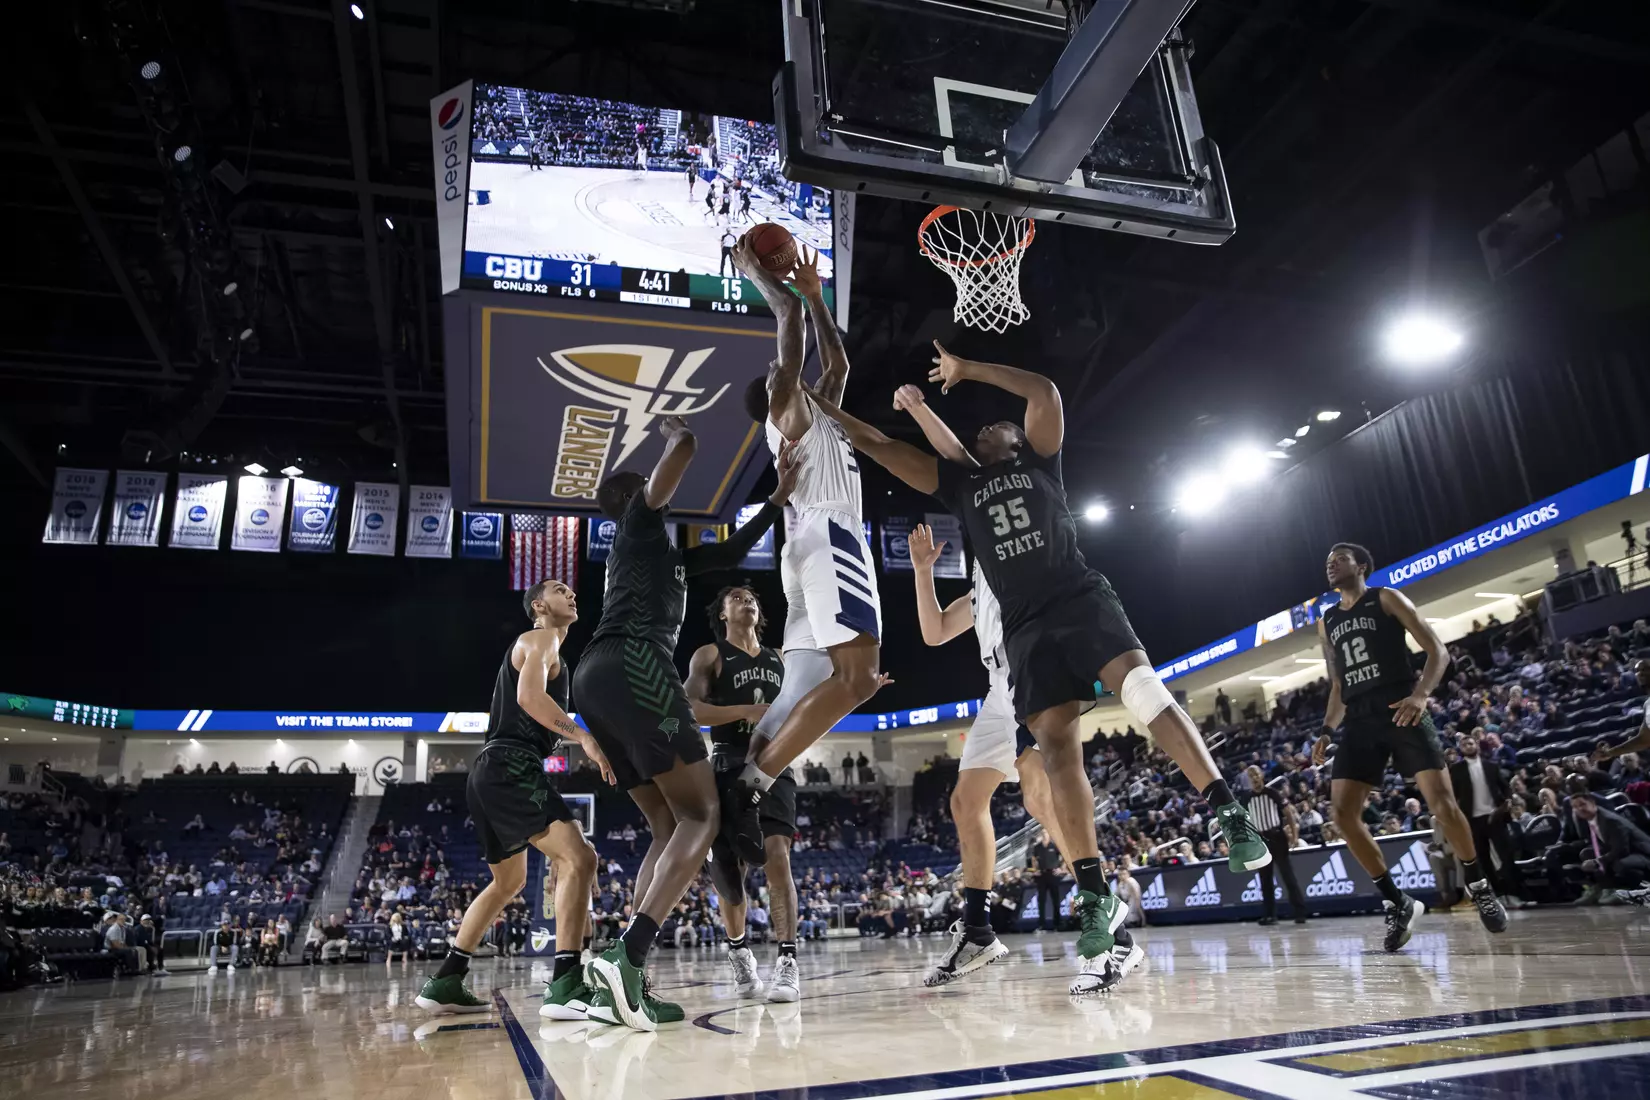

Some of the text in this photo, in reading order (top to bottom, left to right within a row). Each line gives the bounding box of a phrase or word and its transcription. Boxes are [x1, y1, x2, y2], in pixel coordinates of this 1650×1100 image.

[442, 133, 461, 202] pepsi
[839, 189, 850, 252] peps
[485, 255, 543, 281] CBU
[570, 263, 592, 286] 31
[493, 280, 549, 294] BONUS X2
[561, 286, 596, 298] FLS 6
[638, 270, 670, 292] 4:41
[721, 278, 742, 301] 15
[711, 301, 748, 313] FLS 10
[551, 405, 620, 500] LANCERS
[364, 488, 390, 498] 2015
[418, 491, 444, 500] 2014
[973, 473, 1034, 508] CHICAGO
[988, 496, 1031, 536] 35
[995, 530, 1045, 561] STATE
[1389, 503, 1560, 585] LOCATED BY THE ESCALATORS
[1330, 616, 1377, 646] CHICAGO
[1342, 636, 1370, 668] 12
[733, 666, 781, 689] CHICAGO
[1344, 663, 1381, 687] STATE
[909, 707, 939, 725] CBU
[955, 701, 969, 718] 31
[276, 715, 413, 728] VISIT THE TEAM STORE!
[1306, 877, 1355, 897] adidas
[1185, 891, 1222, 907] adidas
